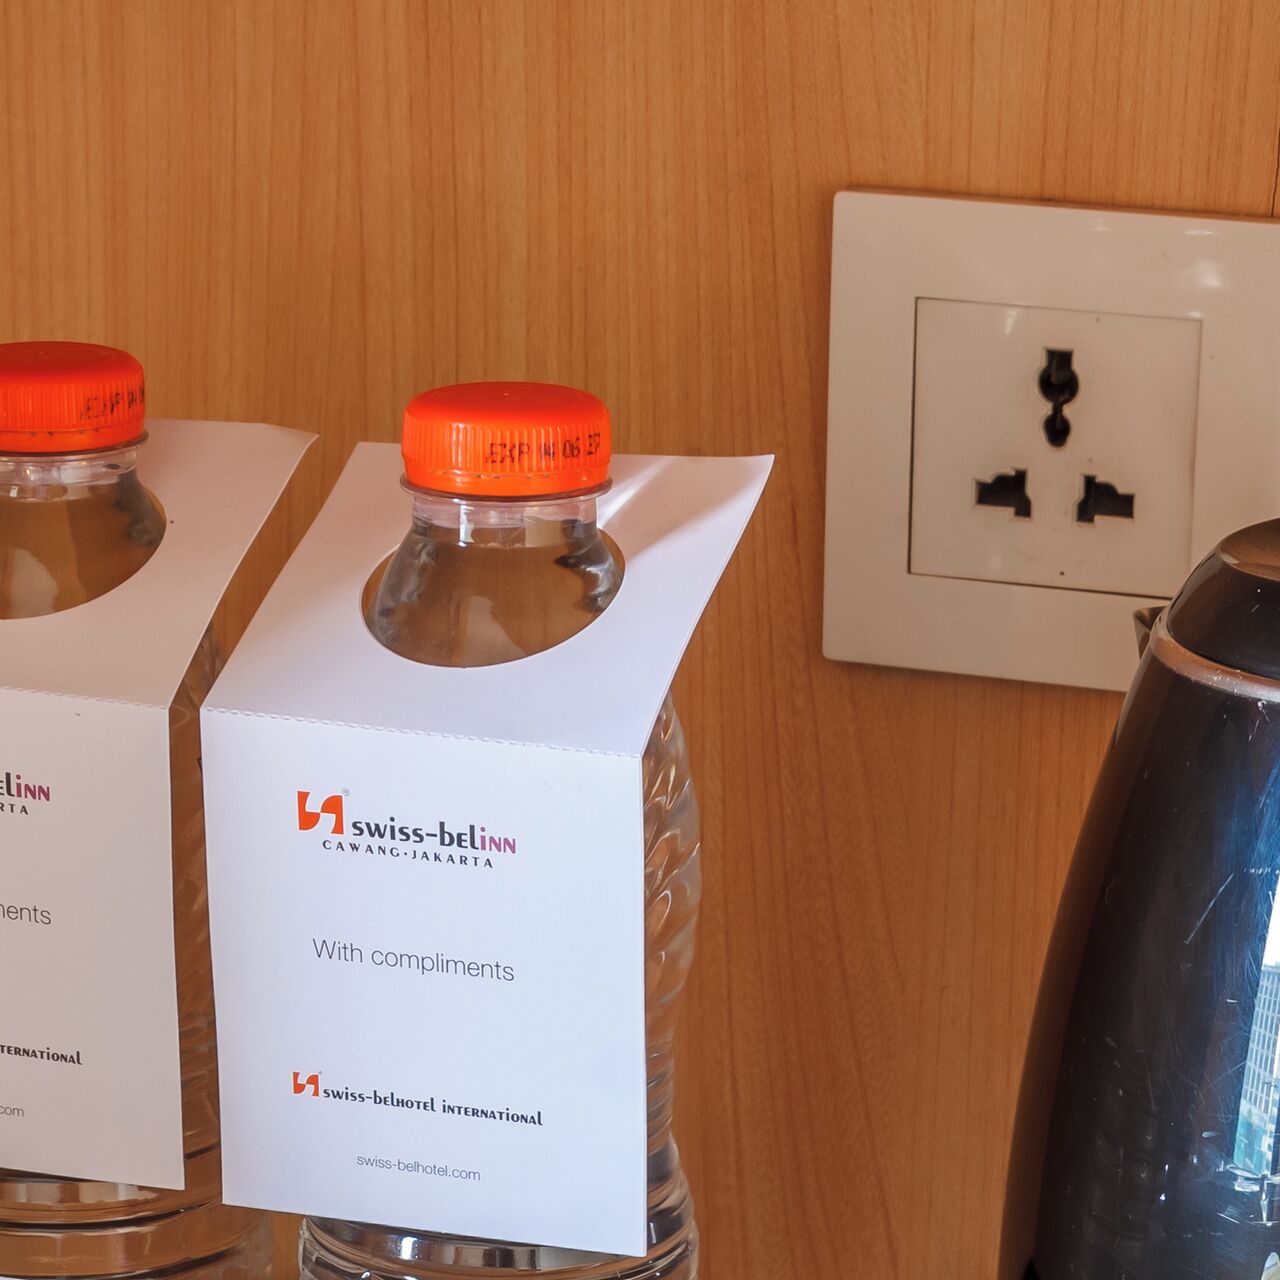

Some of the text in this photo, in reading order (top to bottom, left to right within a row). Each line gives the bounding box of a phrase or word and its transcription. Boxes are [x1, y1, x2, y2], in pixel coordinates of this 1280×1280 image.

[312, 938, 515, 981] With compliments
[356, 1155, 481, 1181] swiss-belhotel.com
